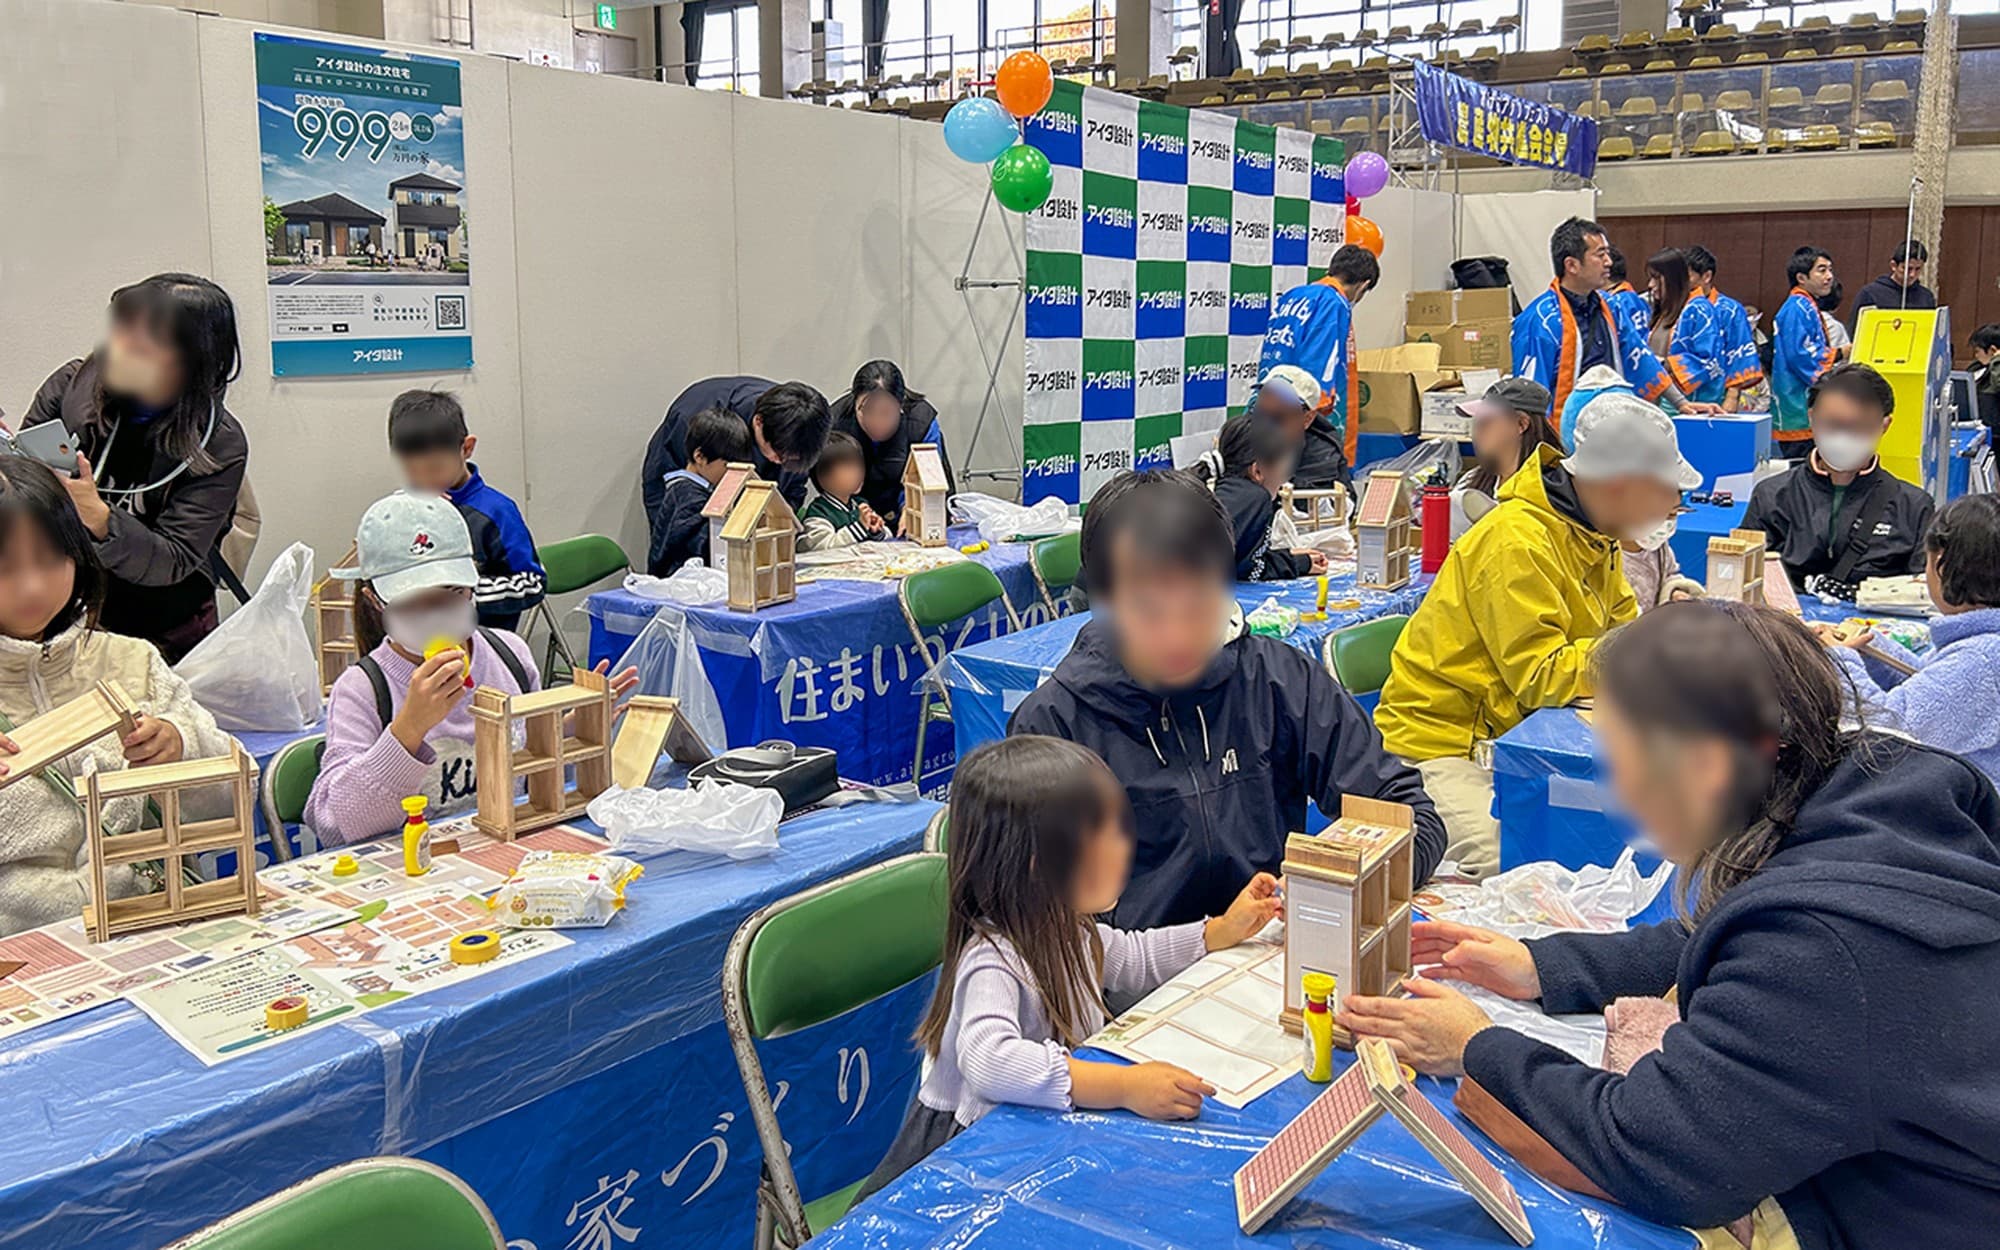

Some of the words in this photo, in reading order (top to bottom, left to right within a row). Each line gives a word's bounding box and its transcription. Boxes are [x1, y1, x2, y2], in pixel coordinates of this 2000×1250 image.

[294, 105, 392, 163] 999
[1087, 120, 1133, 147] アイダ設計
[1142, 132, 1184, 154] アイダ設計
[1192, 140, 1230, 161] アイダ設計
[1028, 199, 1078, 220] イダ設計
[1086, 205, 1133, 229] アイダ設計
[1141, 213, 1183, 232] アイダ設計
[1190, 216, 1229, 235] アイダ設計
[1028, 285, 1078, 305] アイダ設計
[1087, 289, 1131, 309] アイダ設計
[1140, 291, 1182, 309] アイダ設計
[1189, 291, 1226, 308] アイダ設計
[353, 348, 403, 362] アイダ設計
[1027, 371, 1076, 392] アイダ設計
[1085, 371, 1131, 390] アイダ設計
[1139, 367, 1180, 388] アイダ設計
[1186, 363, 1224, 382] アイダ設計
[1025, 455, 1075, 478] アイダ設計
[1084, 450, 1130, 471] アイダ設計
